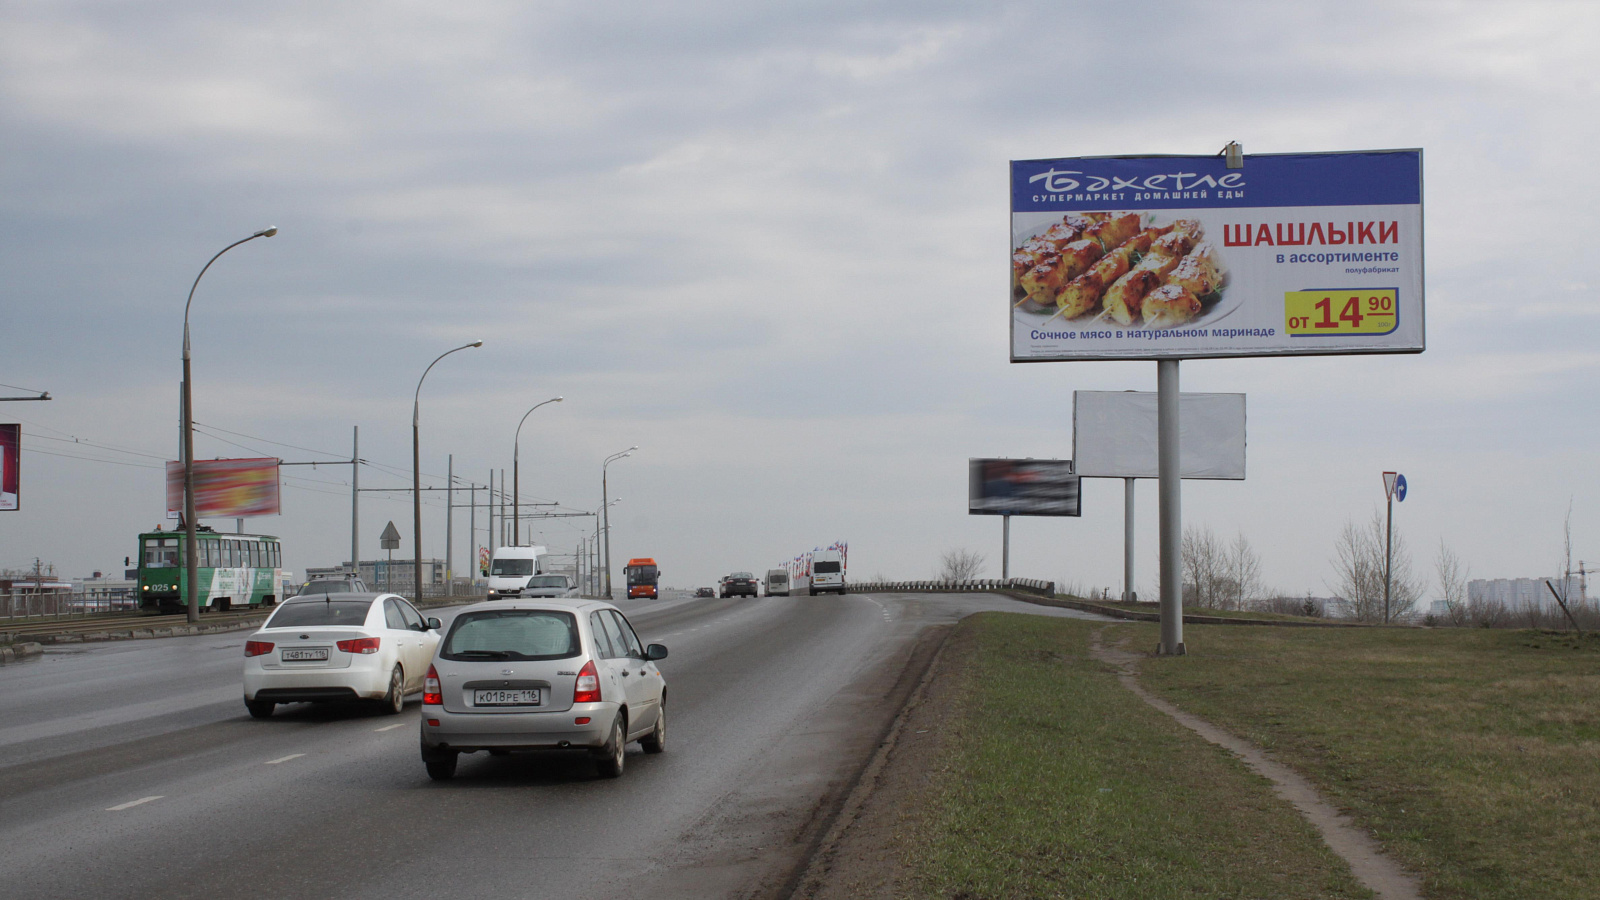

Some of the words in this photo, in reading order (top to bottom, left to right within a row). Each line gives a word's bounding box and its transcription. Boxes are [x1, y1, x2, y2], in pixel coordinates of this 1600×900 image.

[1032, 193, 1125, 202] СУПЕРМАРКЕТ
[1134, 190, 1207, 201] ДОМАШНЕЙ
[1218, 190, 1244, 199] ЕДЫ
[1223, 221, 1399, 247] ШАШЛЫКИ
[1276, 253, 1285, 263] в
[1289, 252, 1399, 265] ассортименте
[1345, 266, 1400, 275] полуфабрикат
[1288, 316, 1310, 329] от
[1314, 297, 1364, 329] 14
[1368, 296, 1392, 311] 90
[1030, 329, 1076, 340] Сочное
[1080, 330, 1112, 340] мясо
[1116, 330, 1123, 339] в
[1126, 329, 1208, 341] натуральном
[1211, 327, 1275, 340] маринаде
[151, 583, 169, 592] 025
[479, 691, 519, 702] К018РЕ
[520, 690, 537, 699] 116
